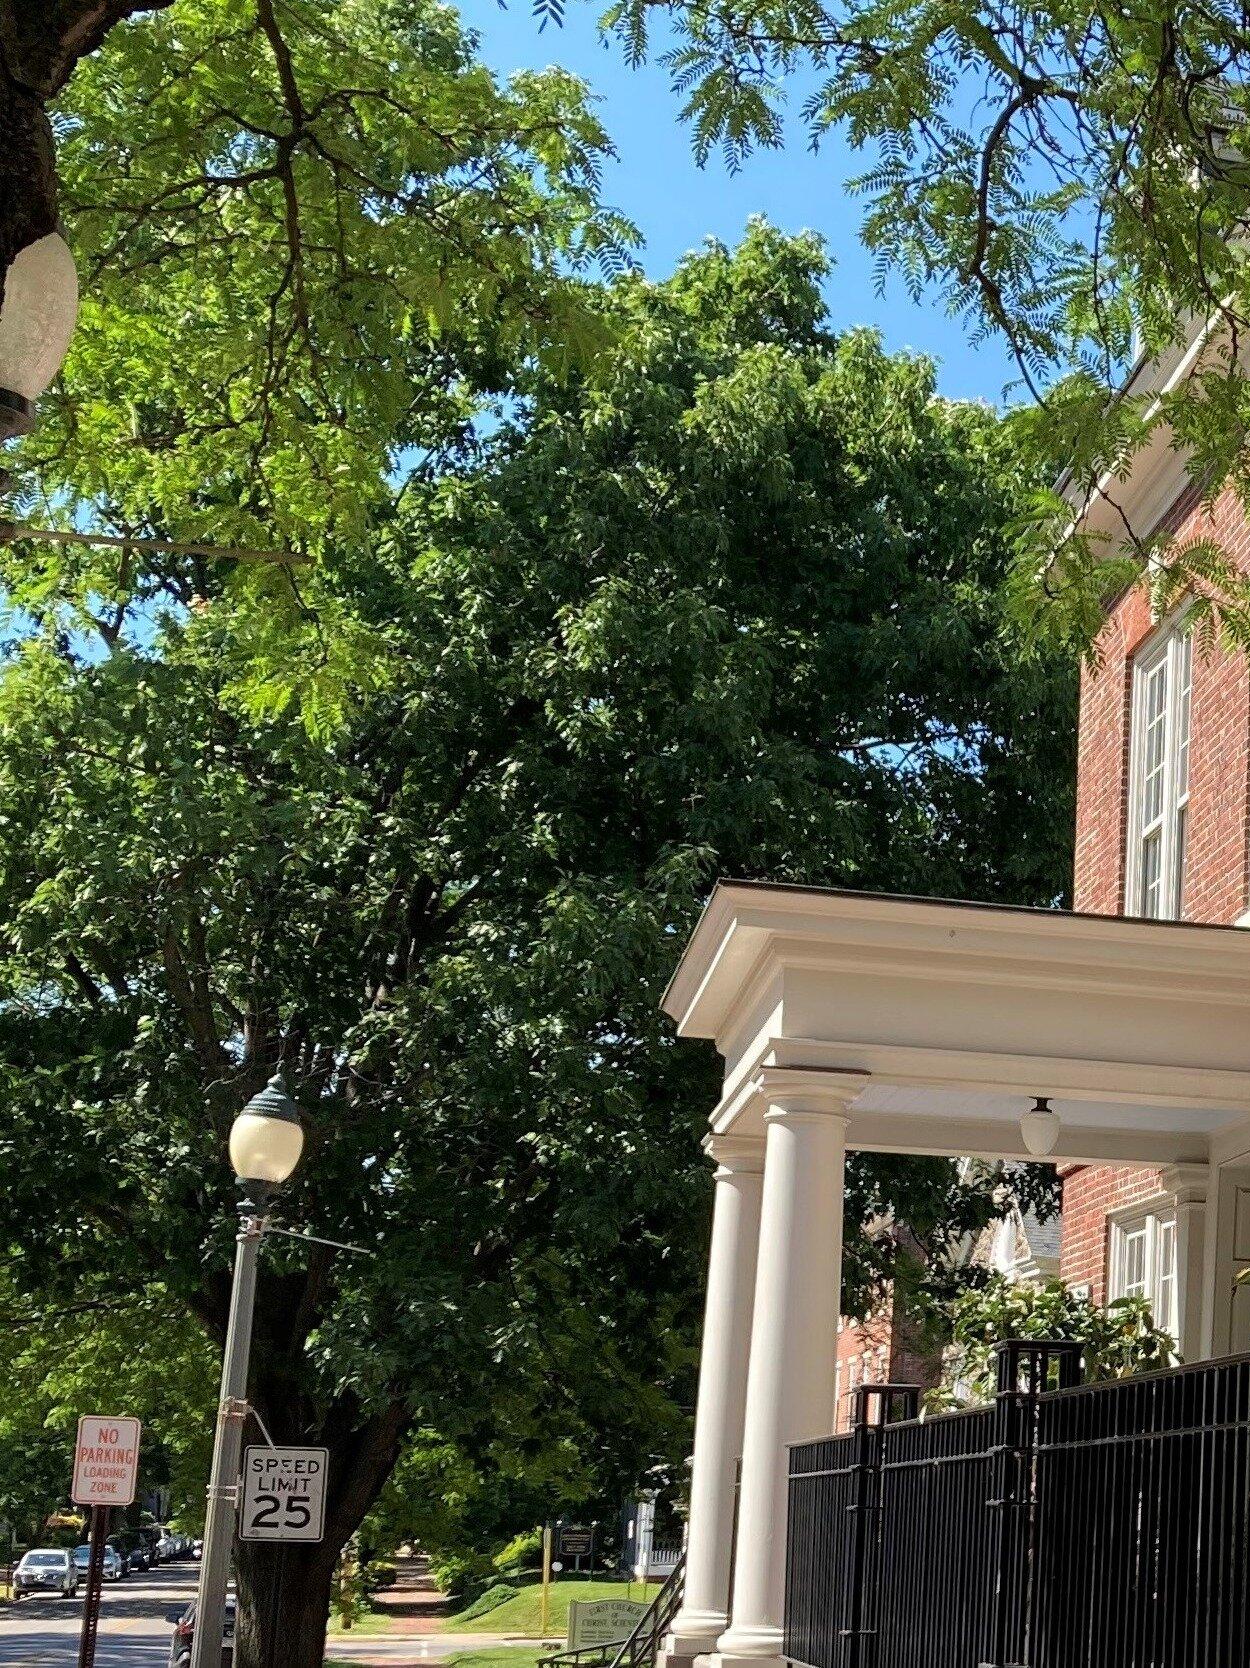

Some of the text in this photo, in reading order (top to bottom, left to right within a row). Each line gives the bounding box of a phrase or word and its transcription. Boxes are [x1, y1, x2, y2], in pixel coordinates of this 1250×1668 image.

[98, 1428, 119, 1444] NO
[80, 1447, 133, 1465] PARKING
[83, 1466, 126, 1479] LOADING
[252, 1458, 320, 1474] SPEED
[89, 1481, 118, 1493] ZONE
[258, 1476, 311, 1493] LIMIT
[251, 1495, 311, 1529] 25
